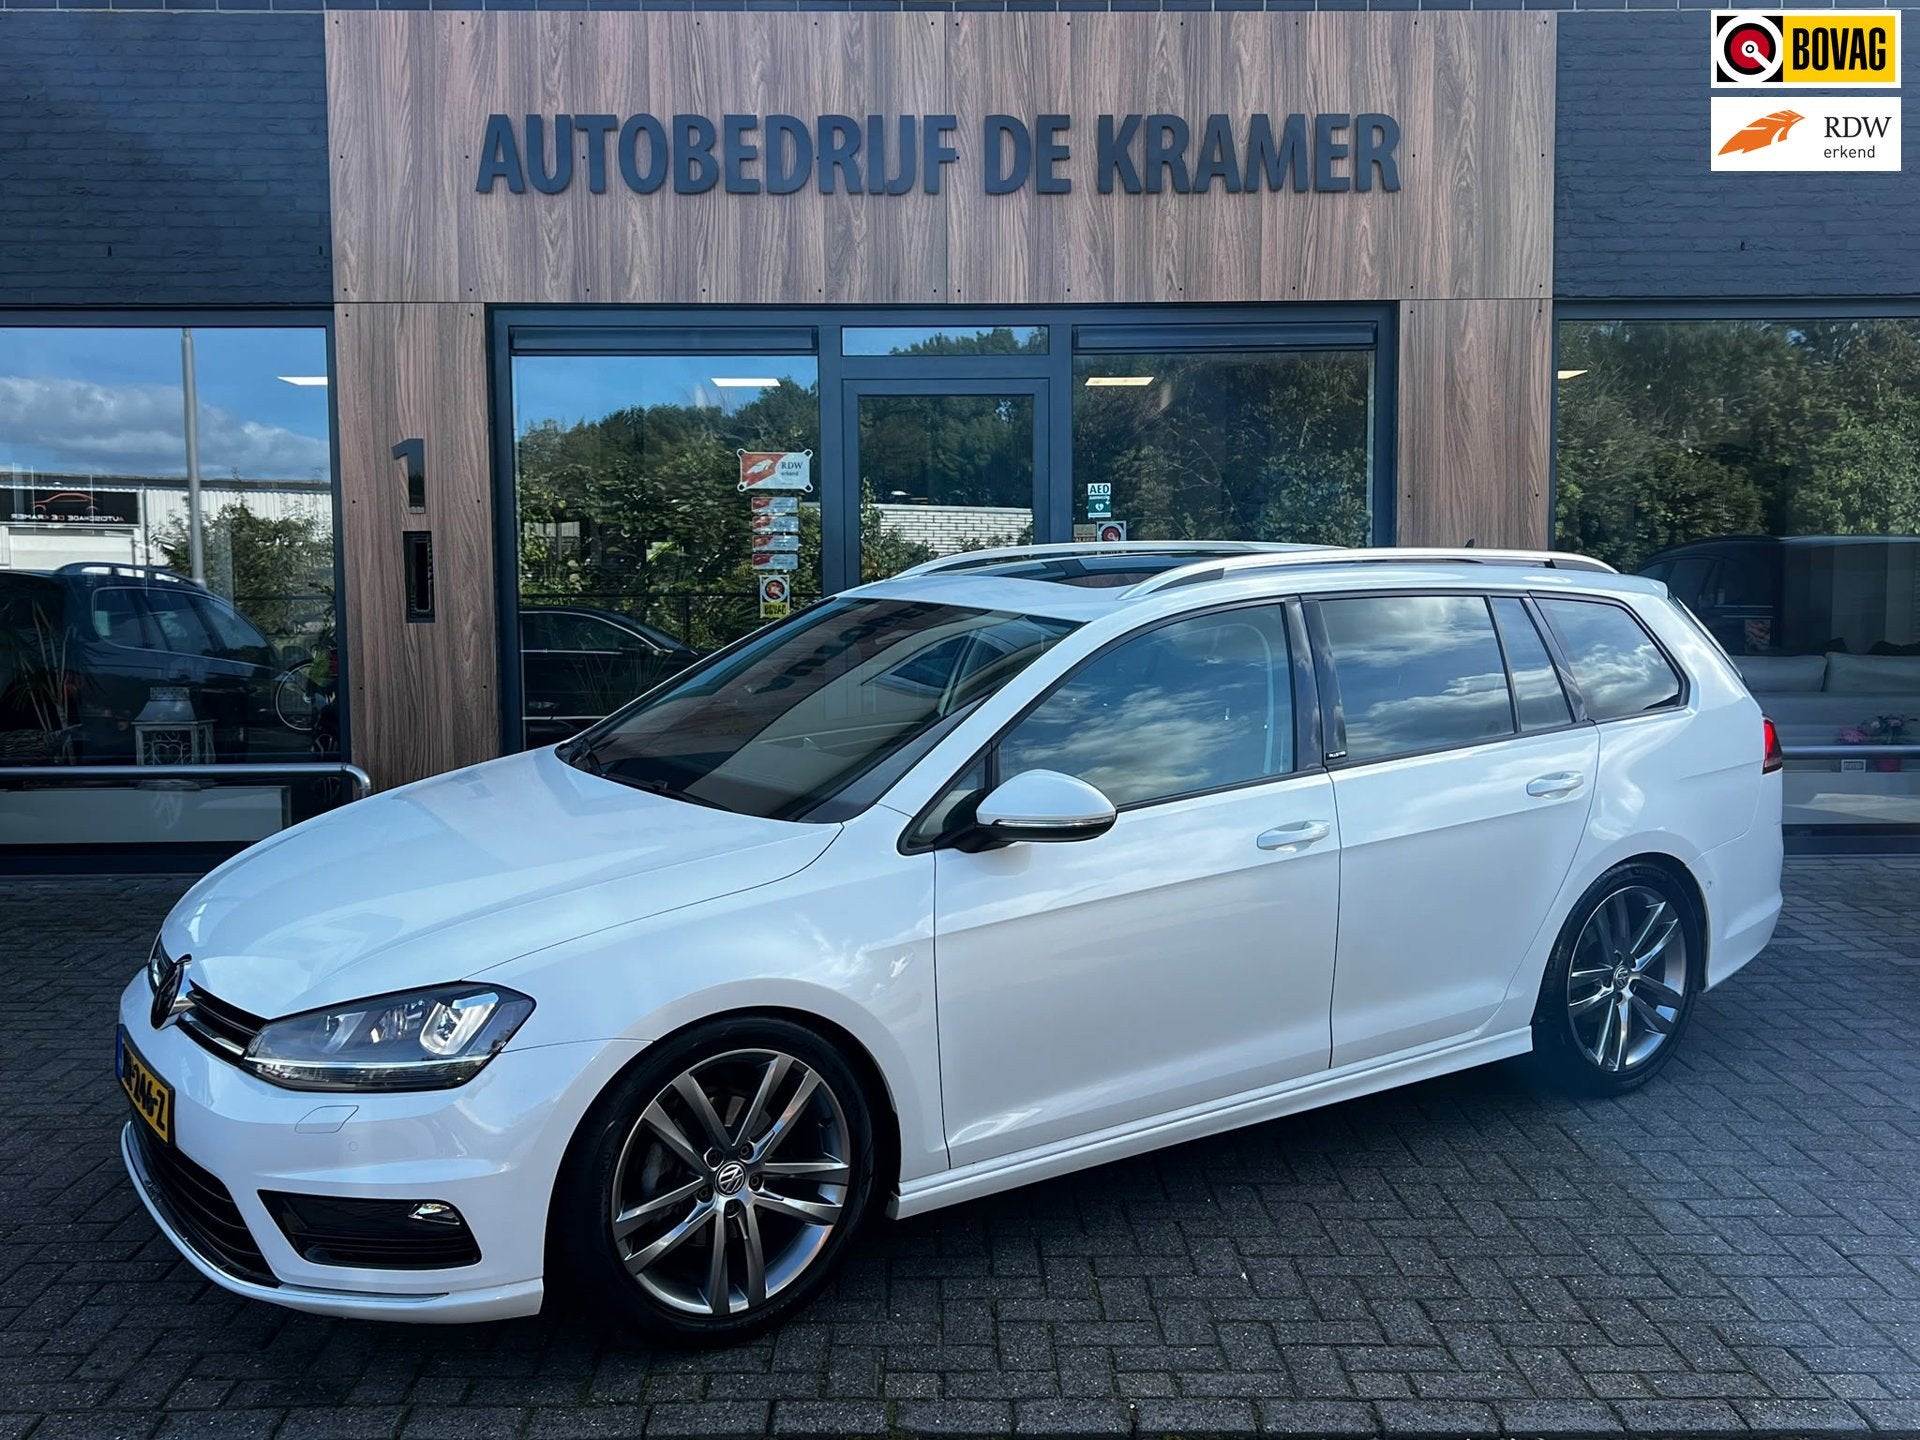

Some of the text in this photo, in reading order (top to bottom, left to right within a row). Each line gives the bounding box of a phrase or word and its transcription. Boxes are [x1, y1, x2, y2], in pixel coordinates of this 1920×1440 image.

[475, 113, 1401, 195] AUTOBEDRIJF DE KRAMER
[391, 438, 425, 514] 1
[781, 461, 803, 470] RDW
[1089, 484, 1110, 494] AED
